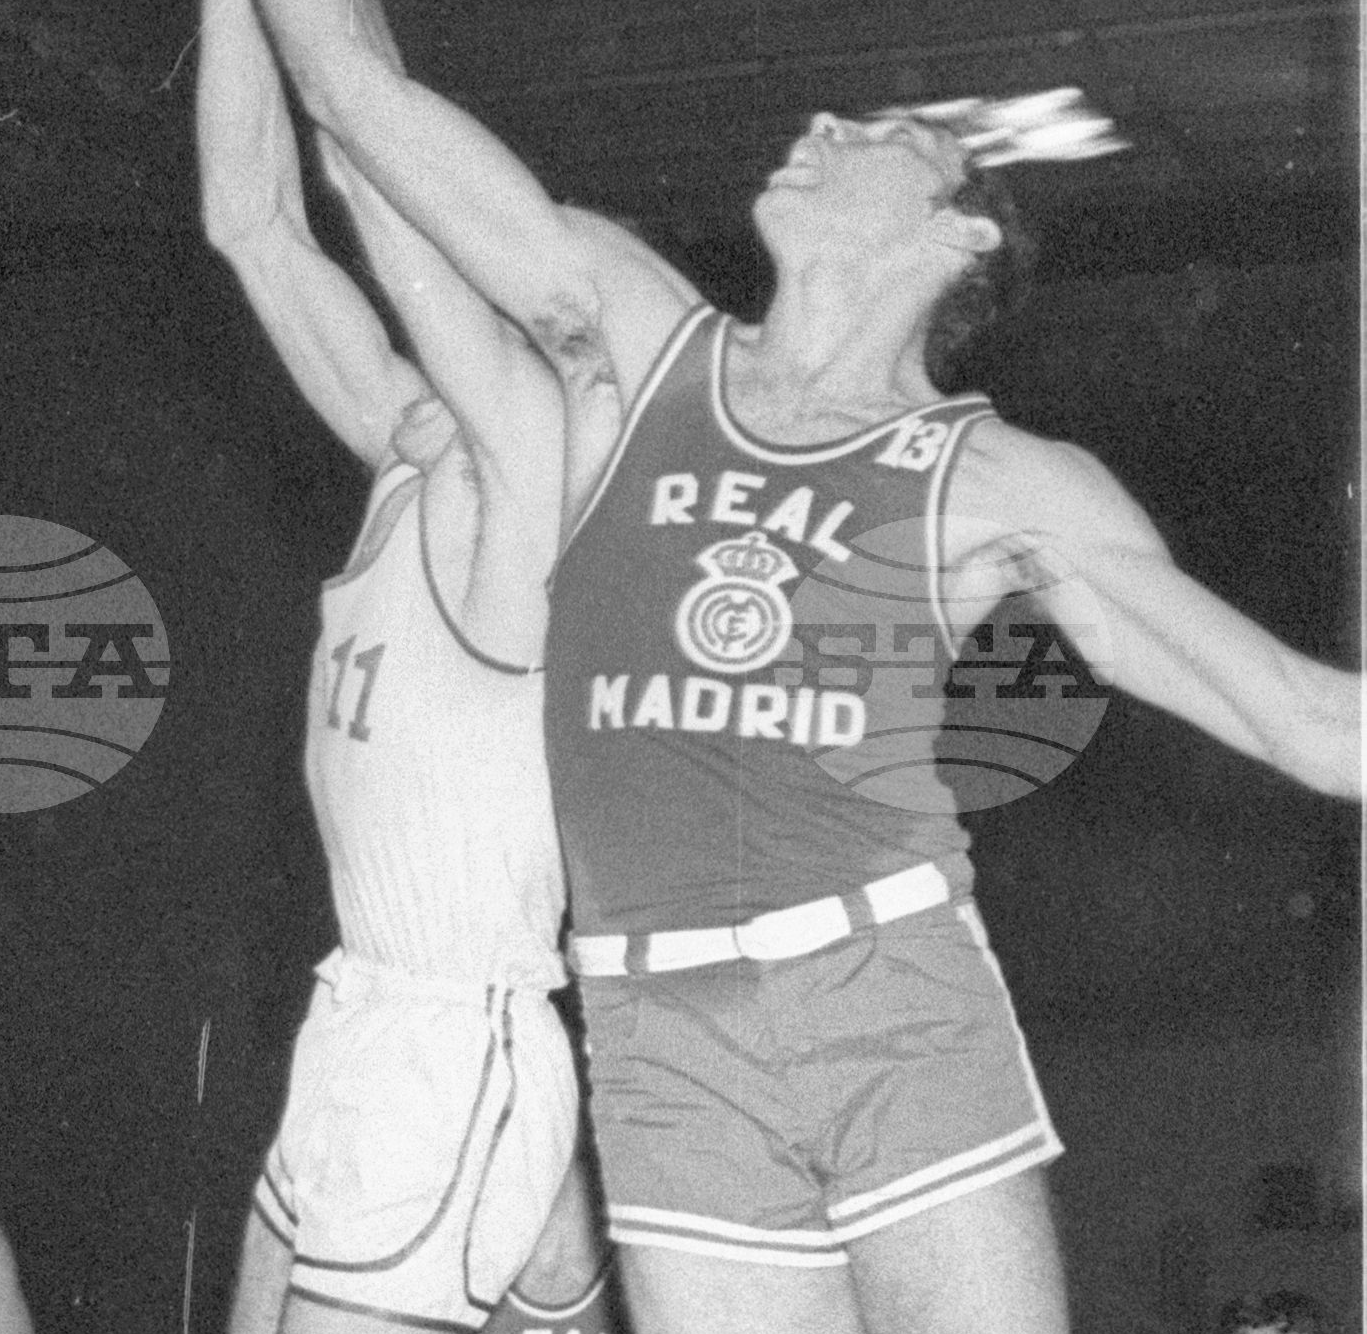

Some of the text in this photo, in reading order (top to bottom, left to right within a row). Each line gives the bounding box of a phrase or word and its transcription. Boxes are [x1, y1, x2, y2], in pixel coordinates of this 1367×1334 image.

[874, 418, 948, 471] 13
[650, 470, 856, 562] REAL
[327, 633, 386, 743] 11
[587, 673, 867, 748] MADRID
